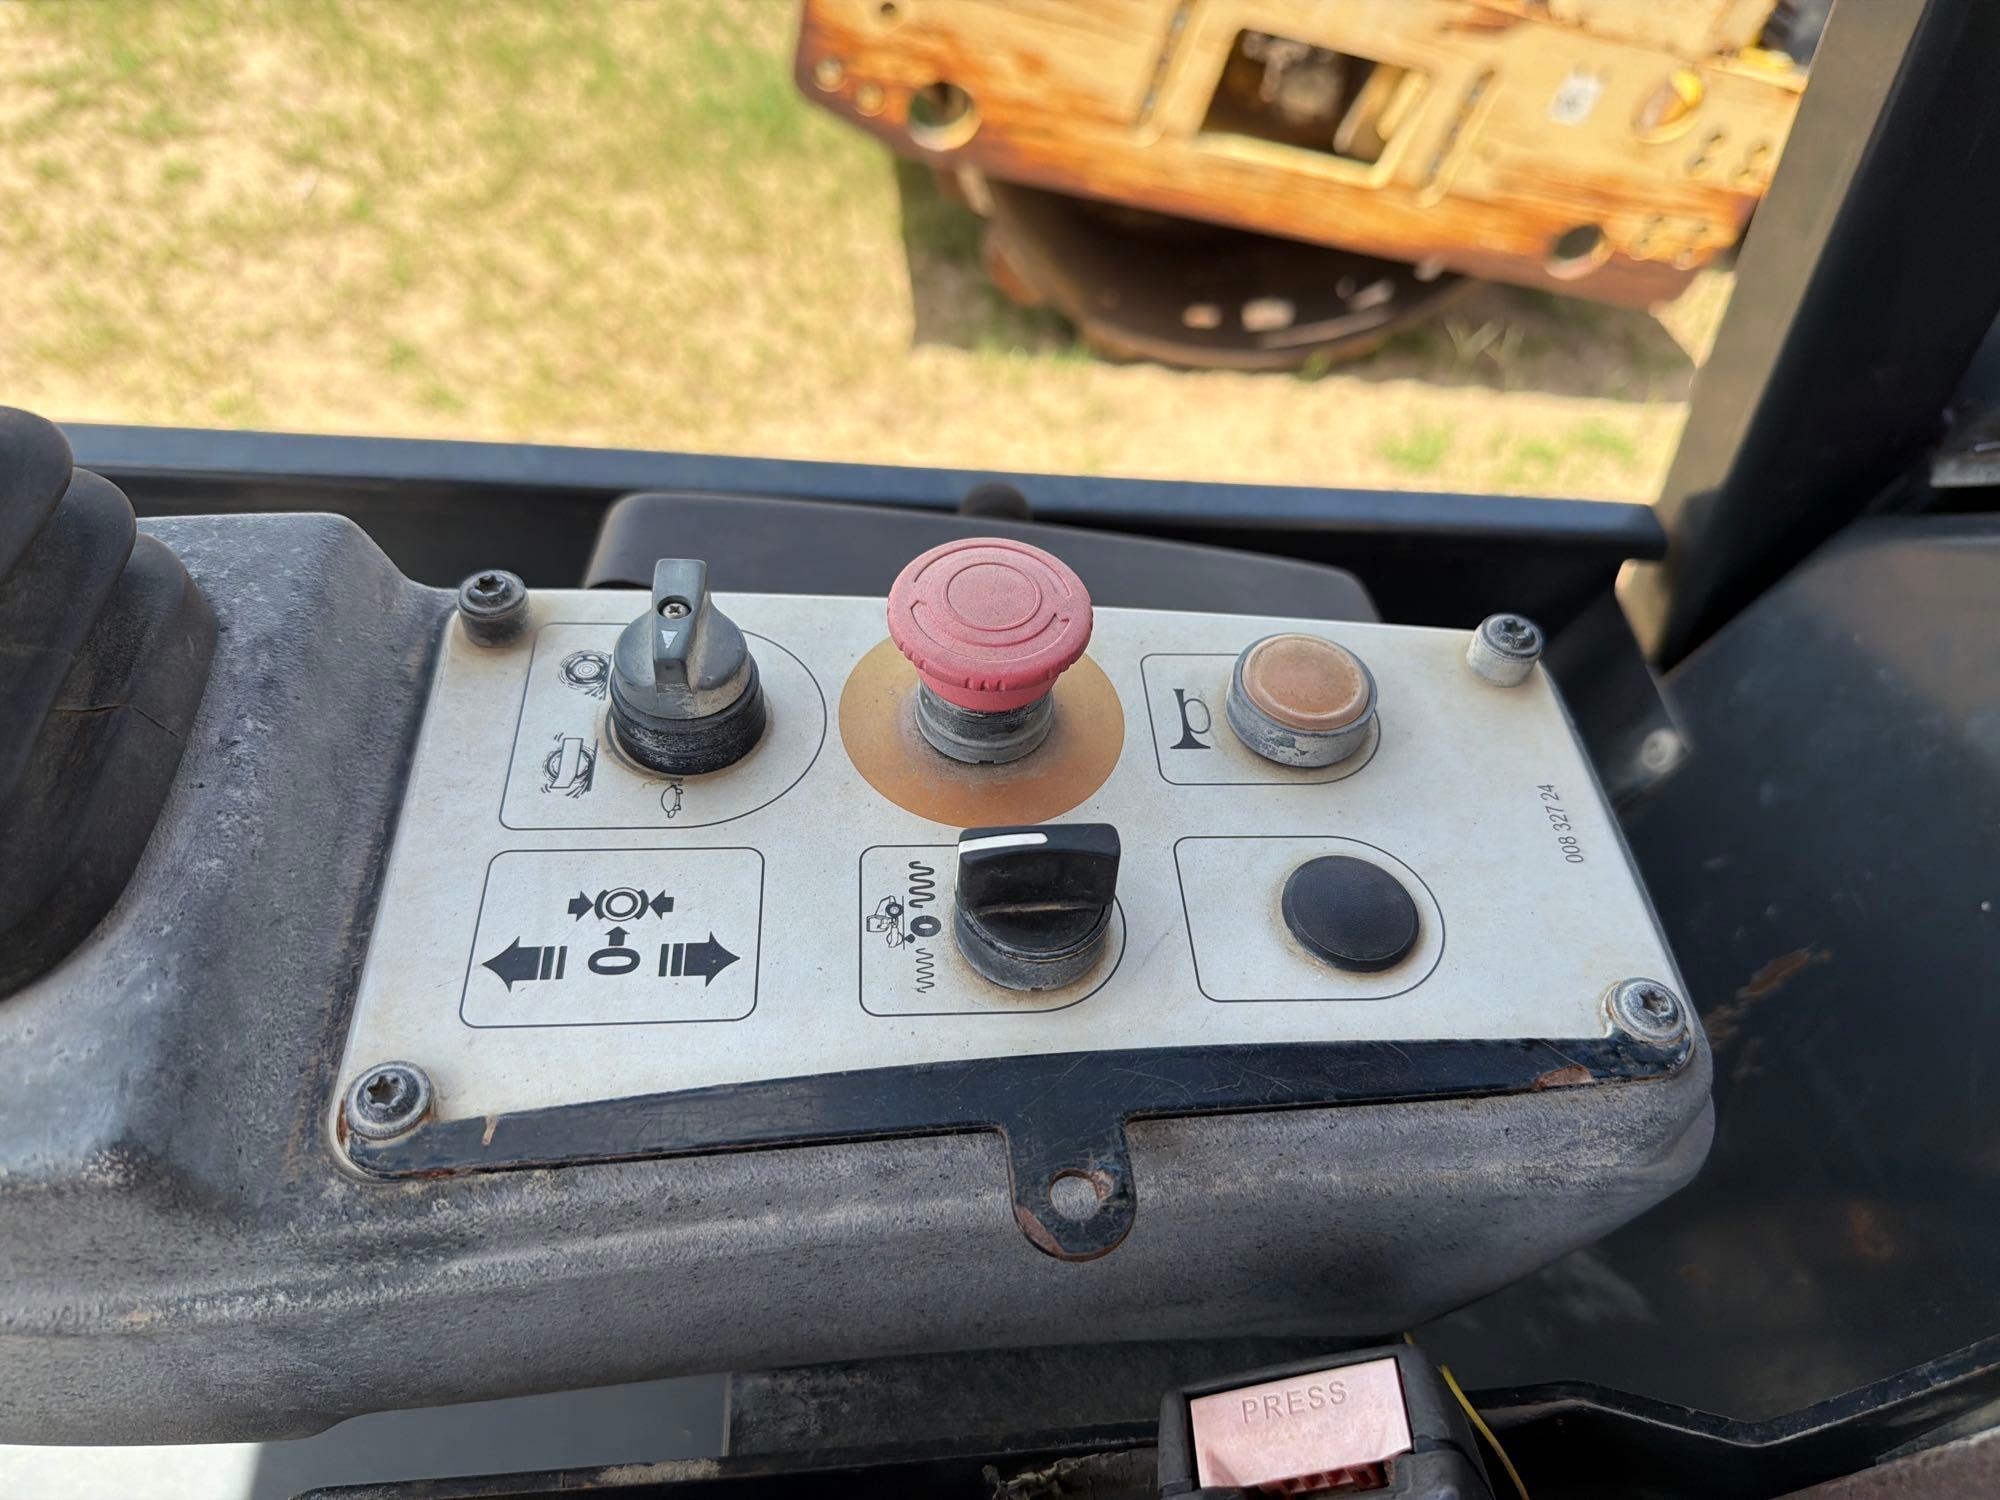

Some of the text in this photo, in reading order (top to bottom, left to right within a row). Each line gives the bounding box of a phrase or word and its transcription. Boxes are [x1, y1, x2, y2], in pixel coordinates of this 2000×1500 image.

[1537, 783, 1584, 863] 008 327 24
[1241, 1380, 1349, 1424] PRESS
